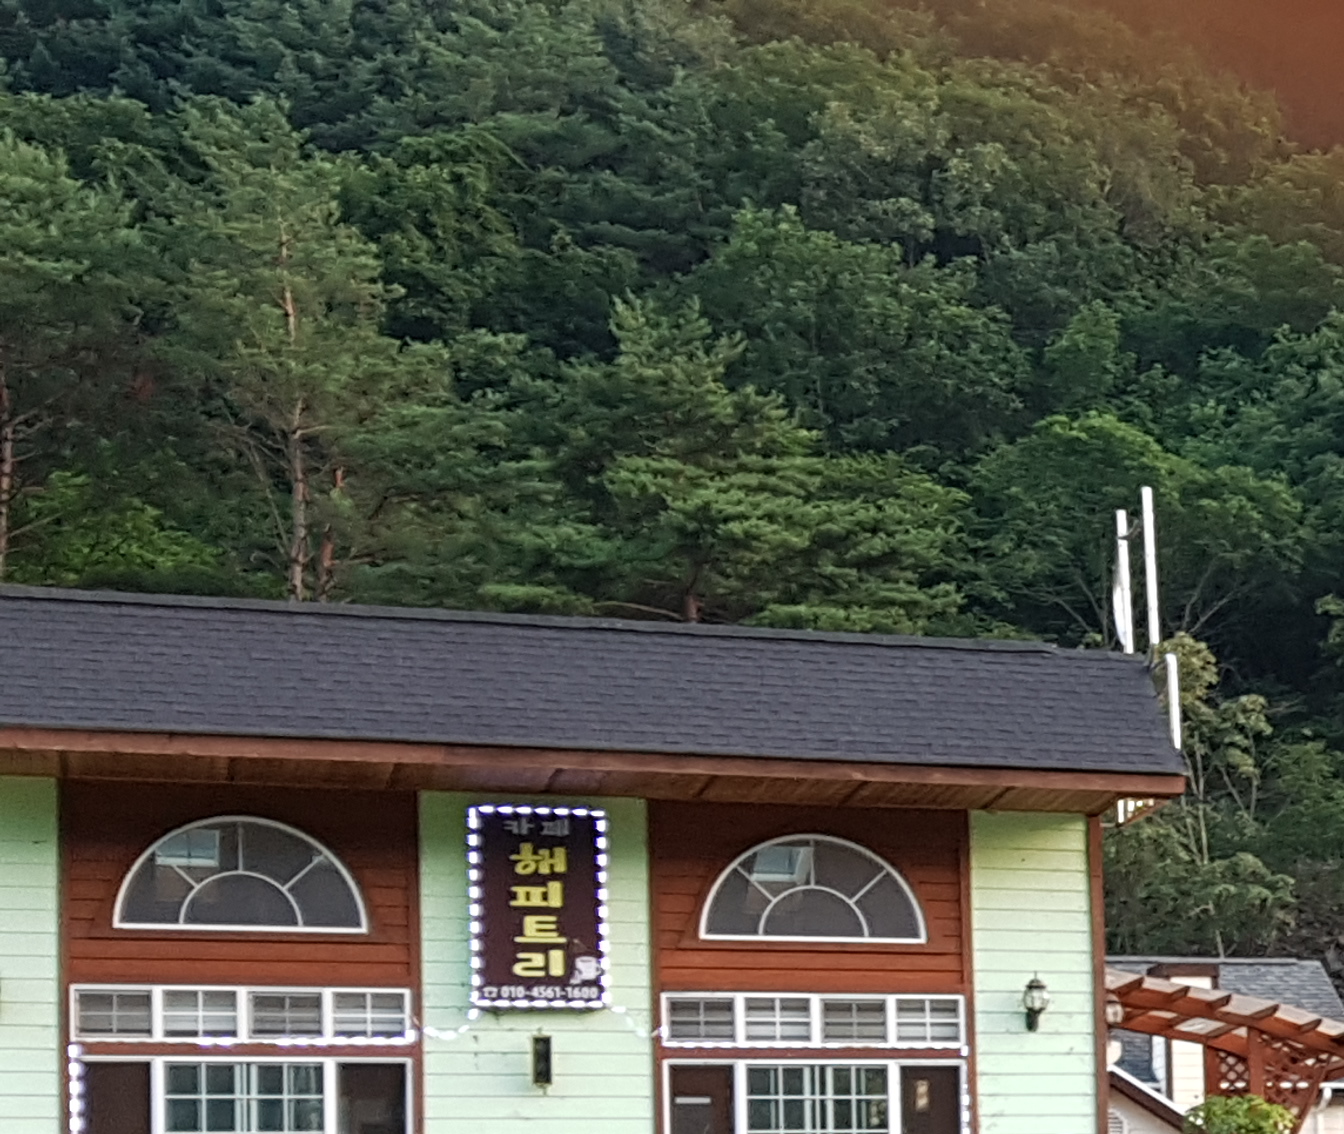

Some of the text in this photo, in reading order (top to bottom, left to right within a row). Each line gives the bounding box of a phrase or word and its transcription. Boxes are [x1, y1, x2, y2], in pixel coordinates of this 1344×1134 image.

[503, 817, 570, 836] 카페
[509, 842, 569, 977] 해피트리
[500, 985, 599, 999] 010-4561-1600
